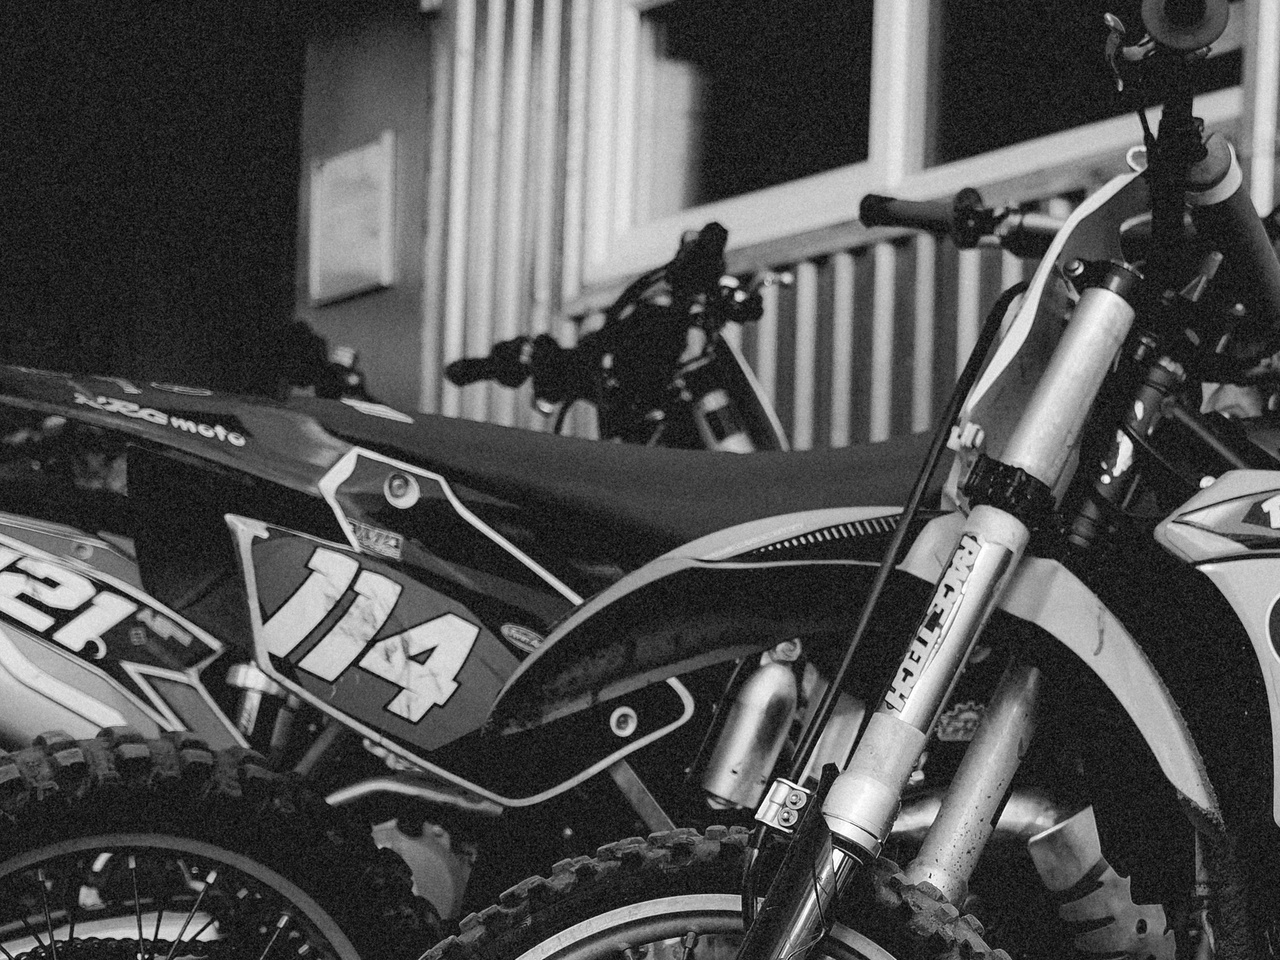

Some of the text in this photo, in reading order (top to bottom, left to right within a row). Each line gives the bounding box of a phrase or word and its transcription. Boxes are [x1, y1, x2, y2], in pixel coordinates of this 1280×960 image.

[0, 546, 138, 652] 21
[262, 547, 480, 723] 114
[885, 534, 982, 712] RACE TECH
